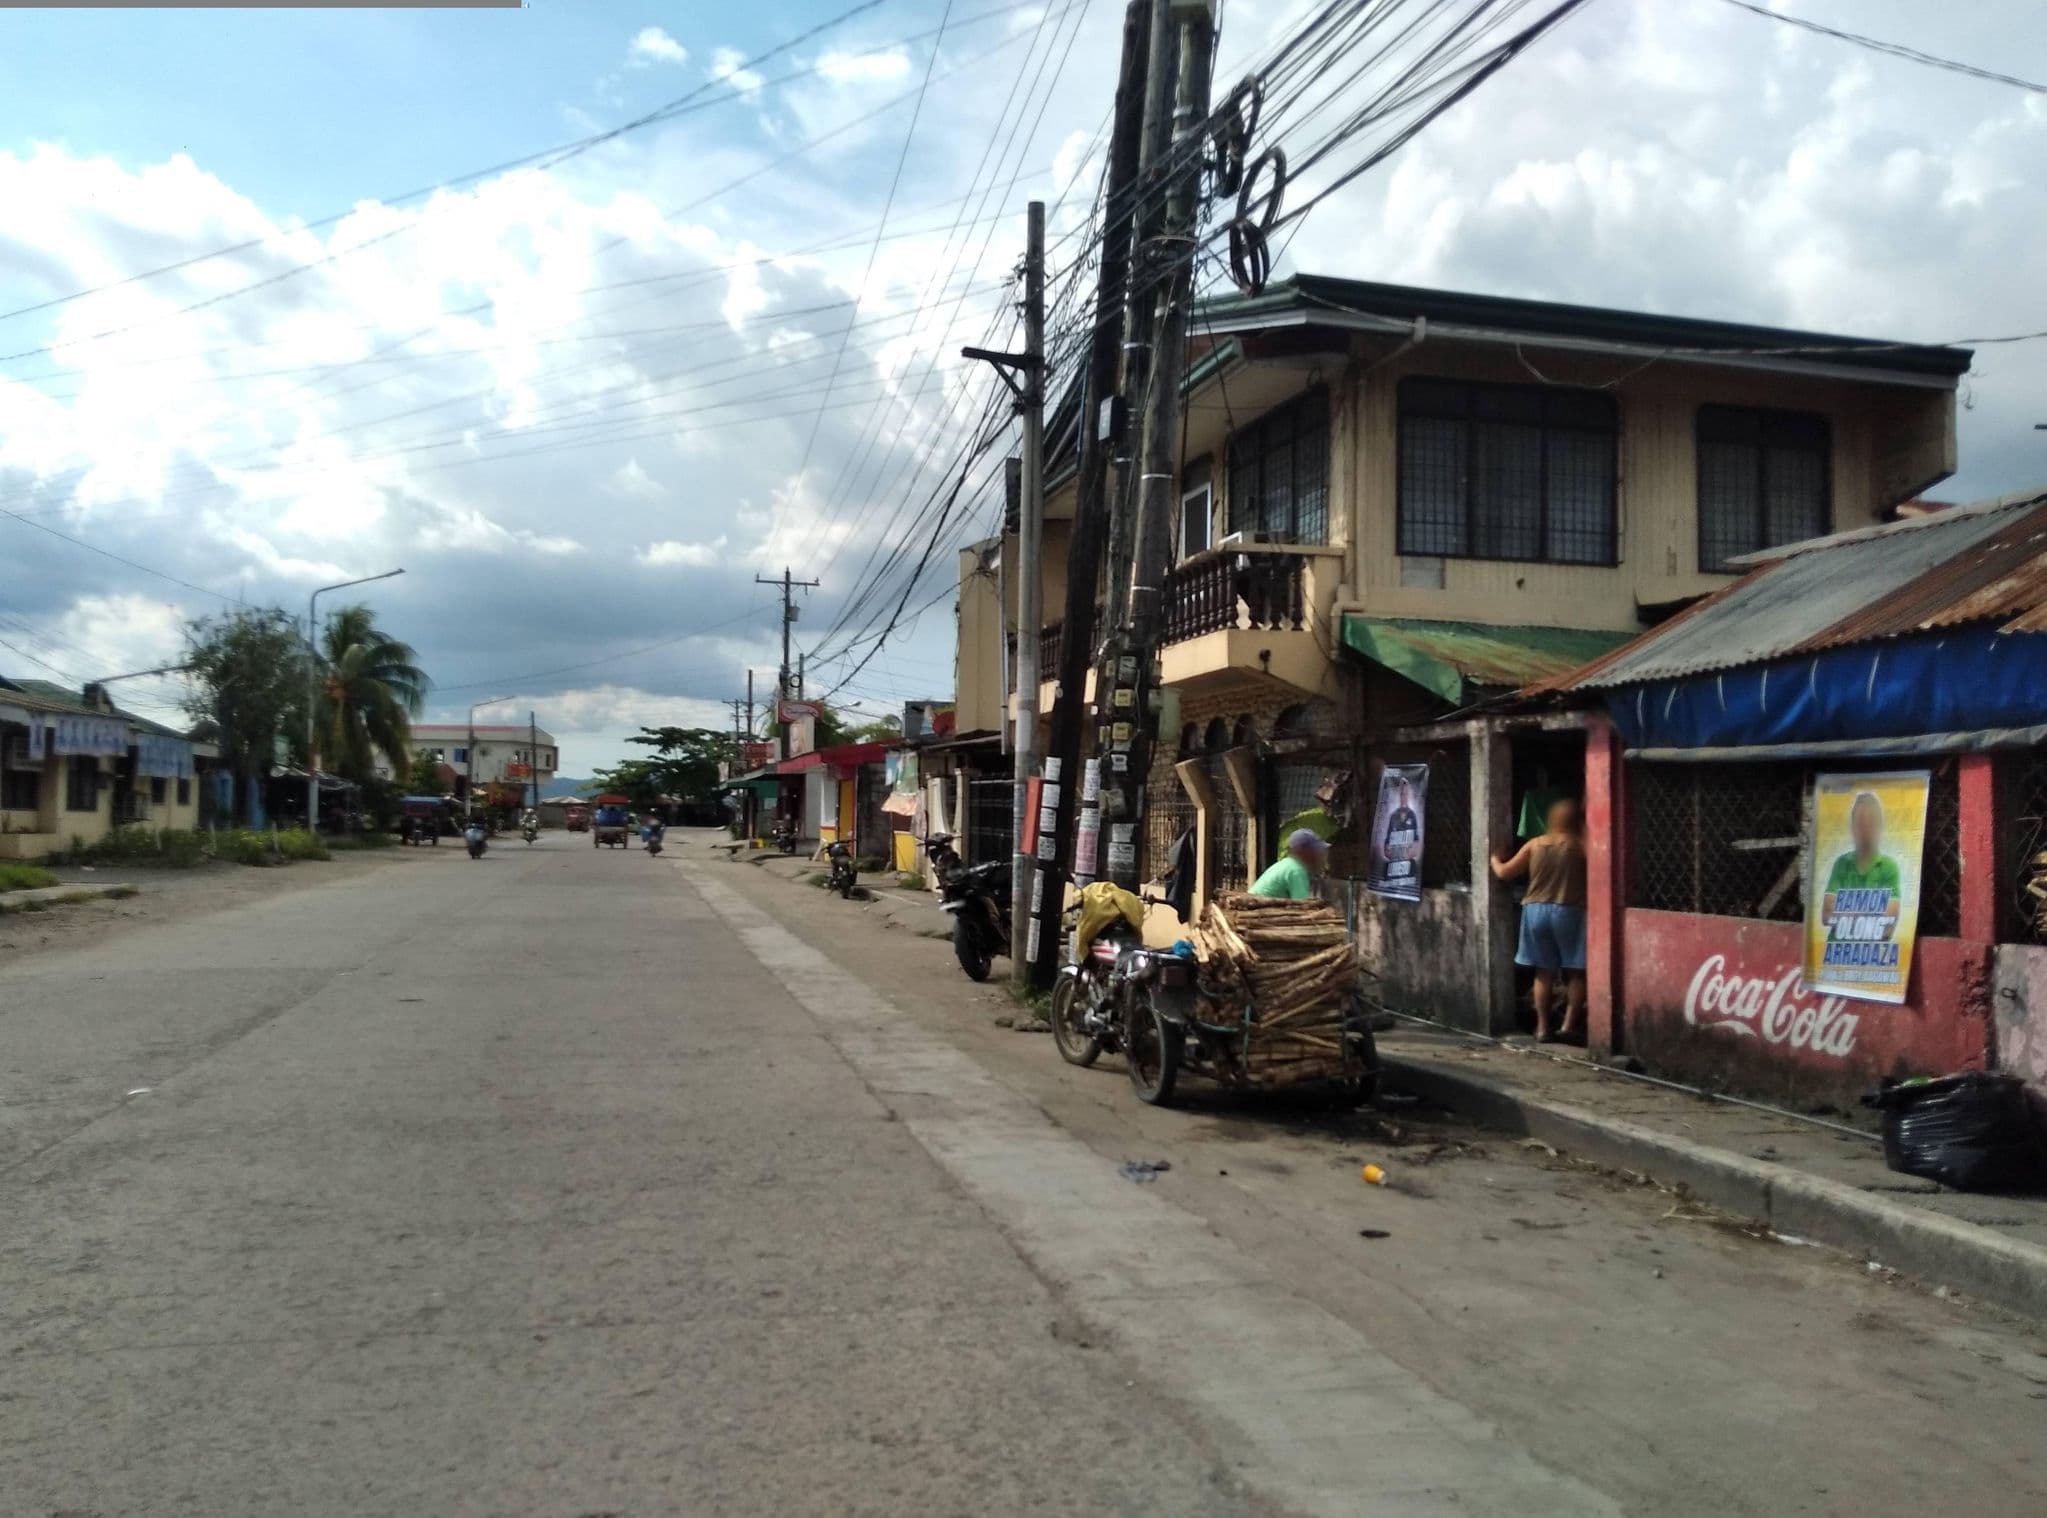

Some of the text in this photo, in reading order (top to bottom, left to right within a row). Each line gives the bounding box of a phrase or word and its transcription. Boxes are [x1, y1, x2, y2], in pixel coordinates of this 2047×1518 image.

[1836, 889, 1890, 912] RAMON
[1823, 942, 1899, 966] ARRADAZA
[1684, 954, 1860, 1057] Coca-Cola
